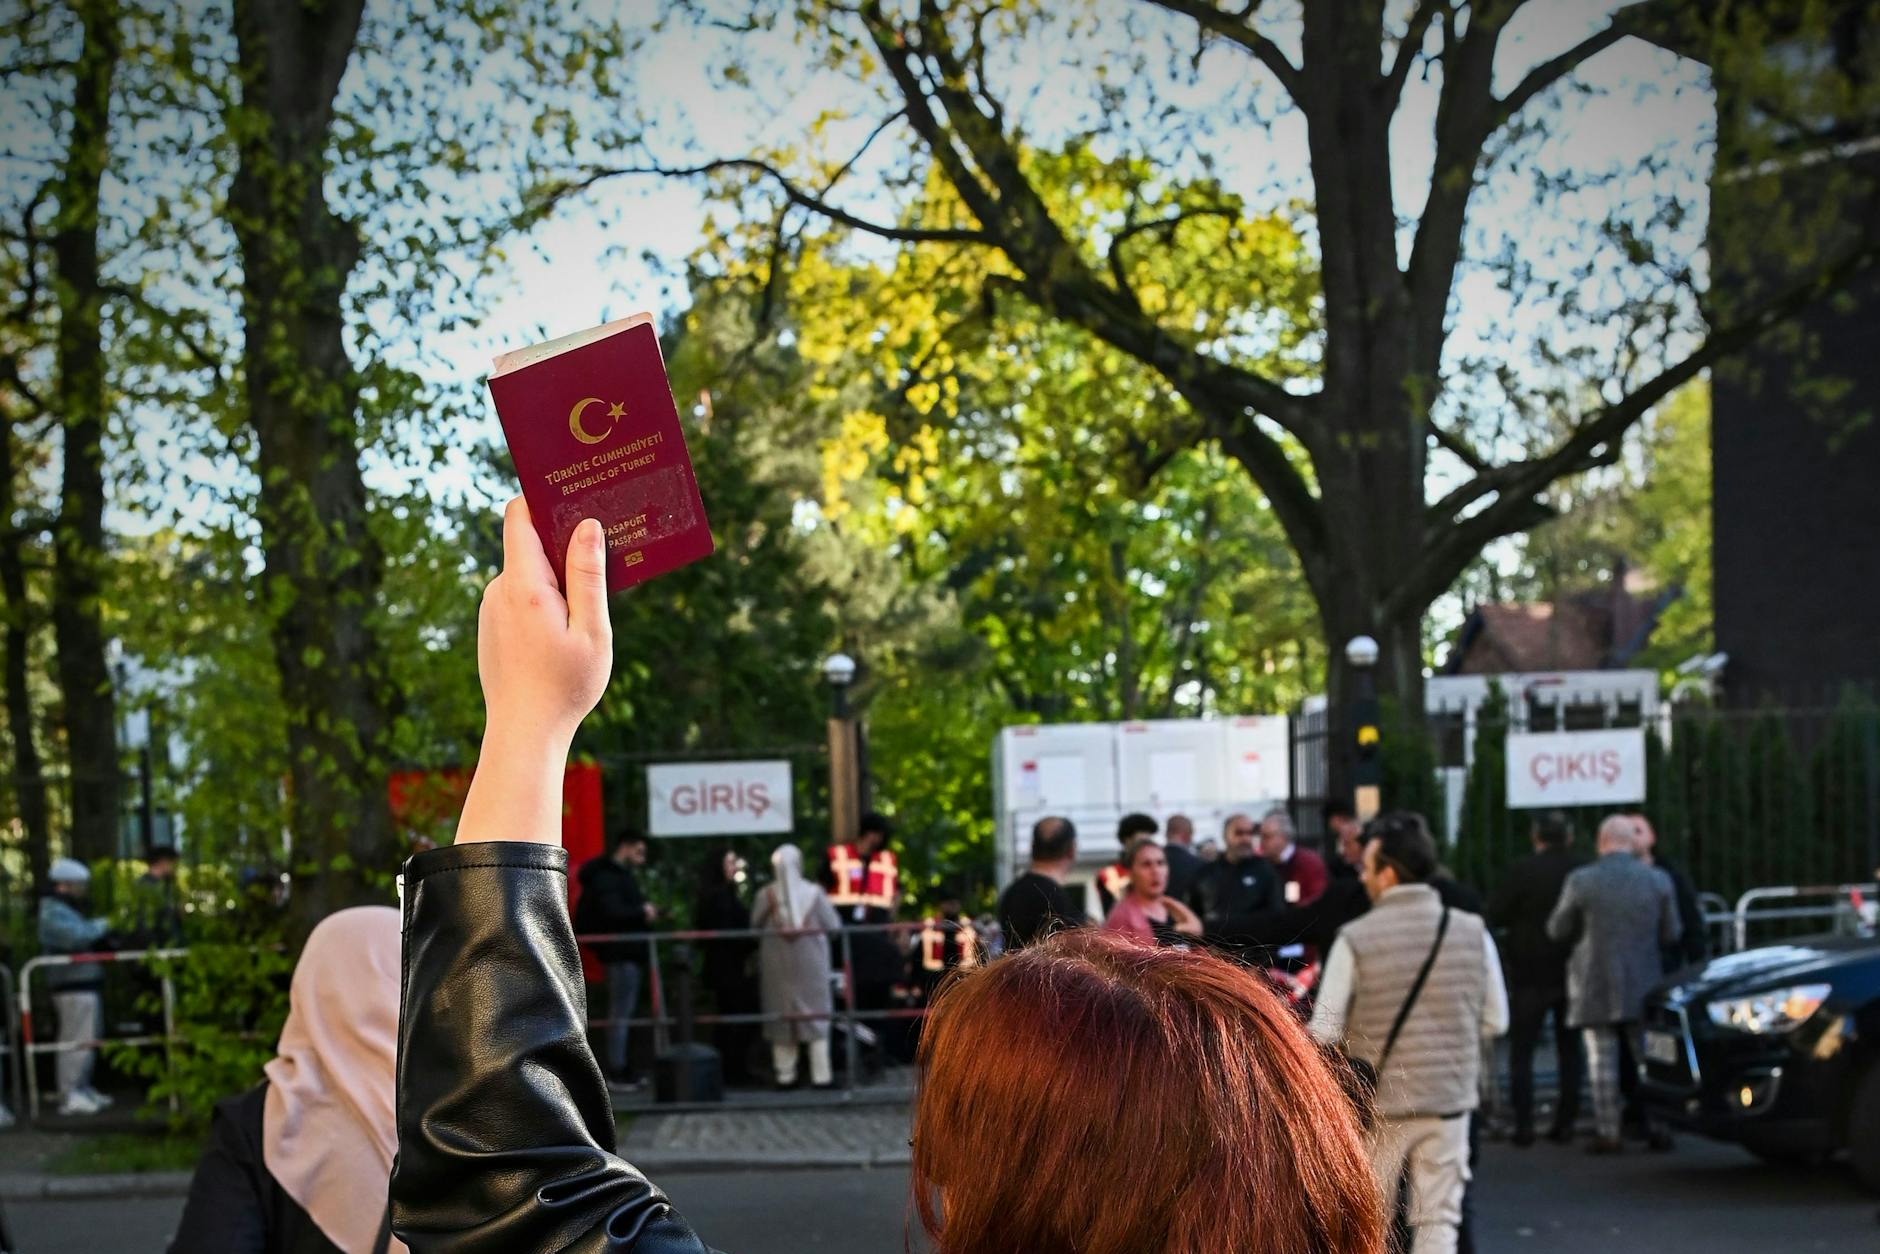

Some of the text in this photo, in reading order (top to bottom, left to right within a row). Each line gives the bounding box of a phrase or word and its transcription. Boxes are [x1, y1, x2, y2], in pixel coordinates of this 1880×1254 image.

[591, 431, 664, 467] CUMHURİYETİ
[561, 453, 656, 496] REPUBLIC OF TURKEY
[608, 527, 647, 549] PASSPORT
[1529, 748, 1622, 791] ÇIKIŞ
[670, 776, 771, 820] GİRİŞ
